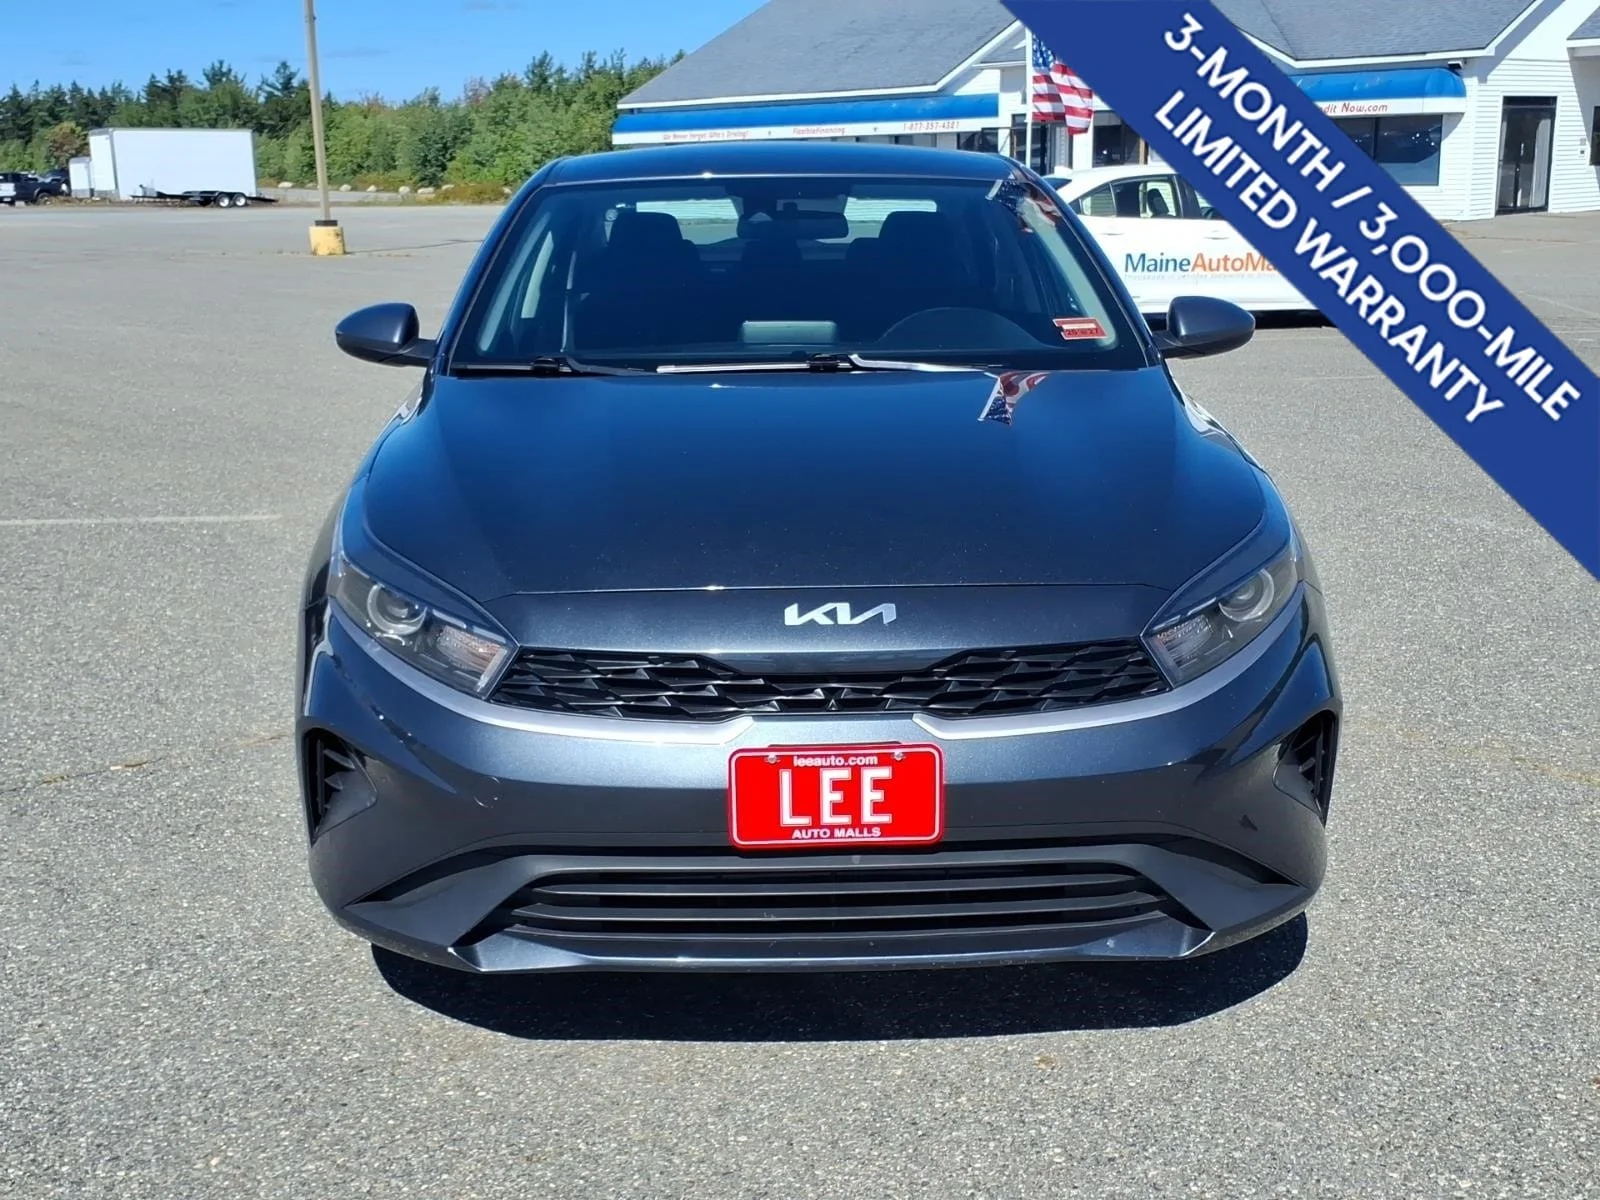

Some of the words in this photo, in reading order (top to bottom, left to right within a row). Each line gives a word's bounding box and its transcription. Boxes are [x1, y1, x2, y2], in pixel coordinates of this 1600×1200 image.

[1341, 102, 1388, 113] Now.com
[784, 602, 897, 626] KIA
[793, 755, 878, 768] leeauto.com
[779, 766, 893, 827] LEE
[792, 828, 831, 840] AUTO
[833, 827, 881, 839] MALLS
